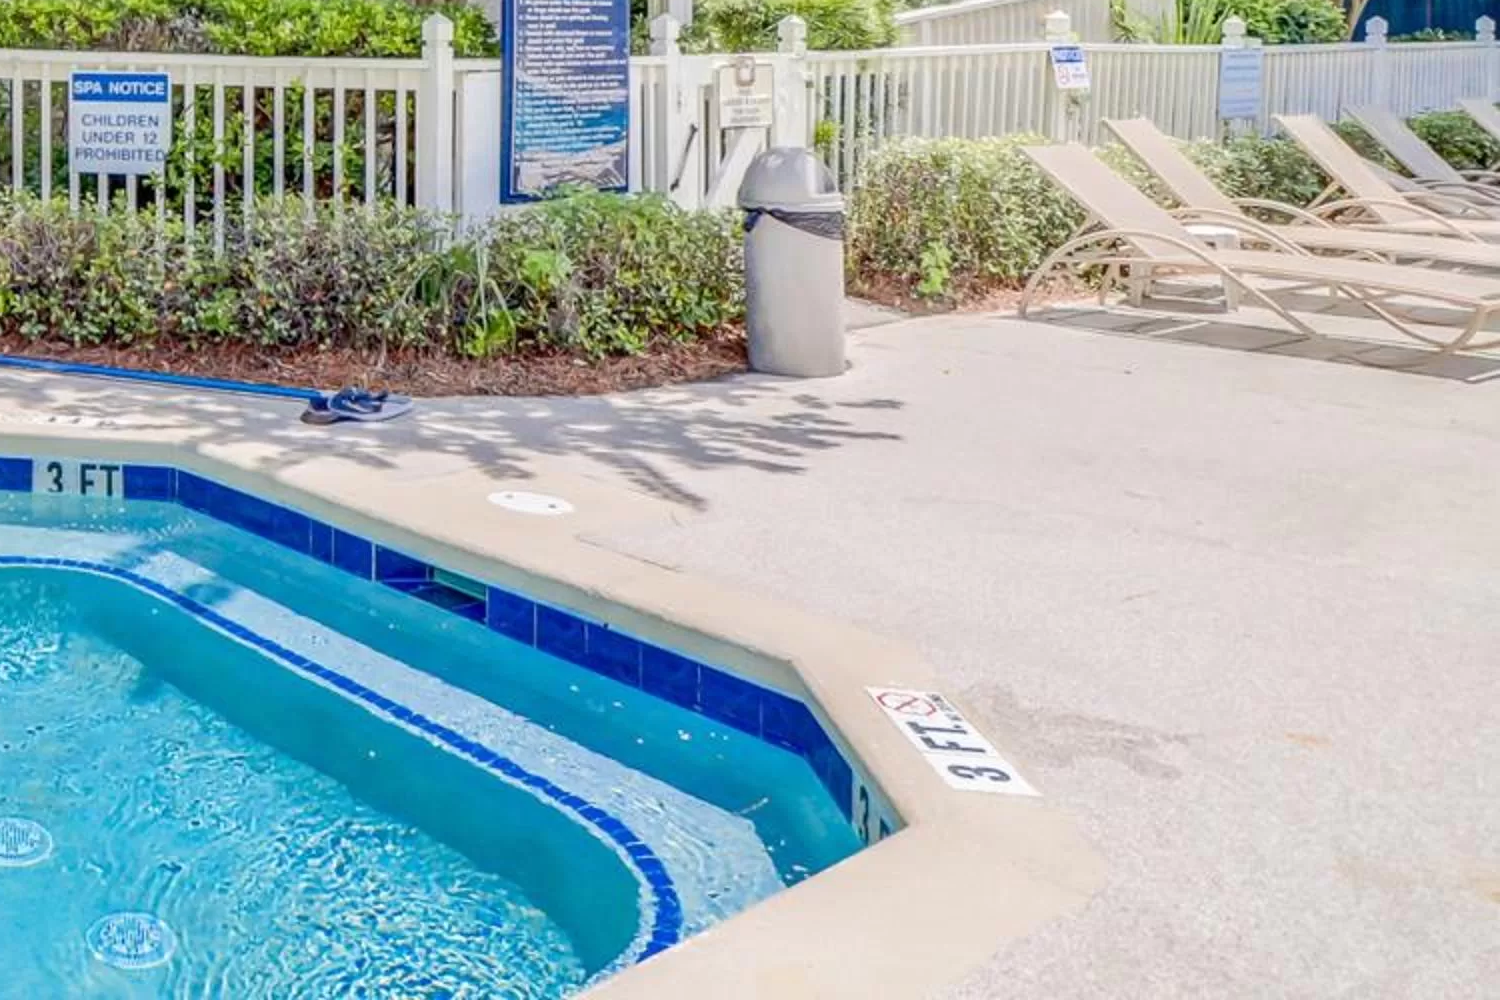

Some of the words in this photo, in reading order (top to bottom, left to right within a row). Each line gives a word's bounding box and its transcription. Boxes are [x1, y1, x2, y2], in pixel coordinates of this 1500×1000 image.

[73, 81, 103, 95] SPA
[108, 81, 165, 95] NOTICE
[81, 113, 159, 127] CHILDREN
[81, 131, 135, 145] UNDER
[143, 131, 158, 145] 12
[74, 146, 166, 162] PROHIBITED
[47, 461, 64, 493] 3
[80, 463, 119, 497] FT
[948, 764, 1011, 783] 3
